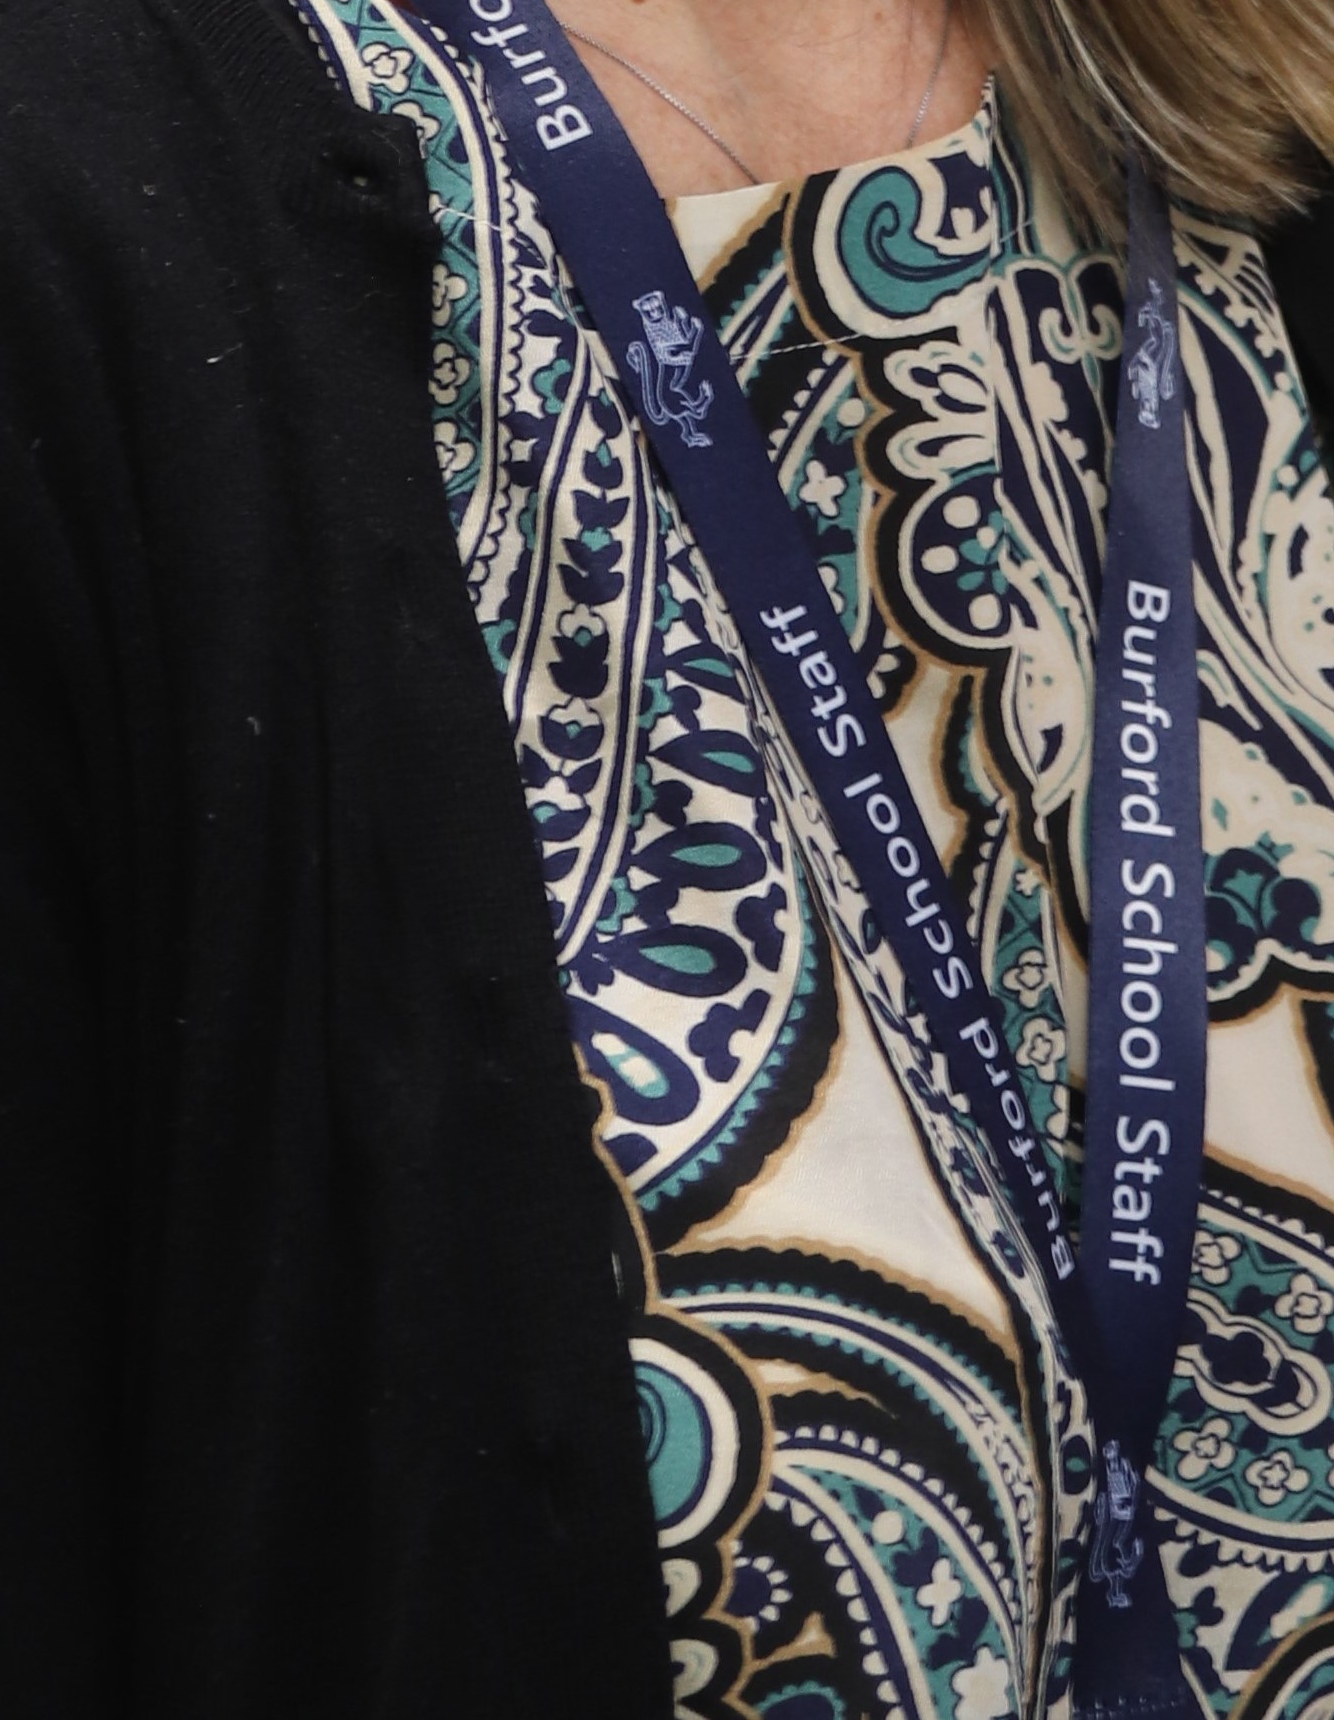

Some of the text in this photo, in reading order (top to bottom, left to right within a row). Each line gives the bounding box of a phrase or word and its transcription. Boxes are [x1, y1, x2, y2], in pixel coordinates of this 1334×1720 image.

[759, 604, 1075, 1280] Burford School Staff
[1108, 580, 1179, 1288] Burford School Staff
